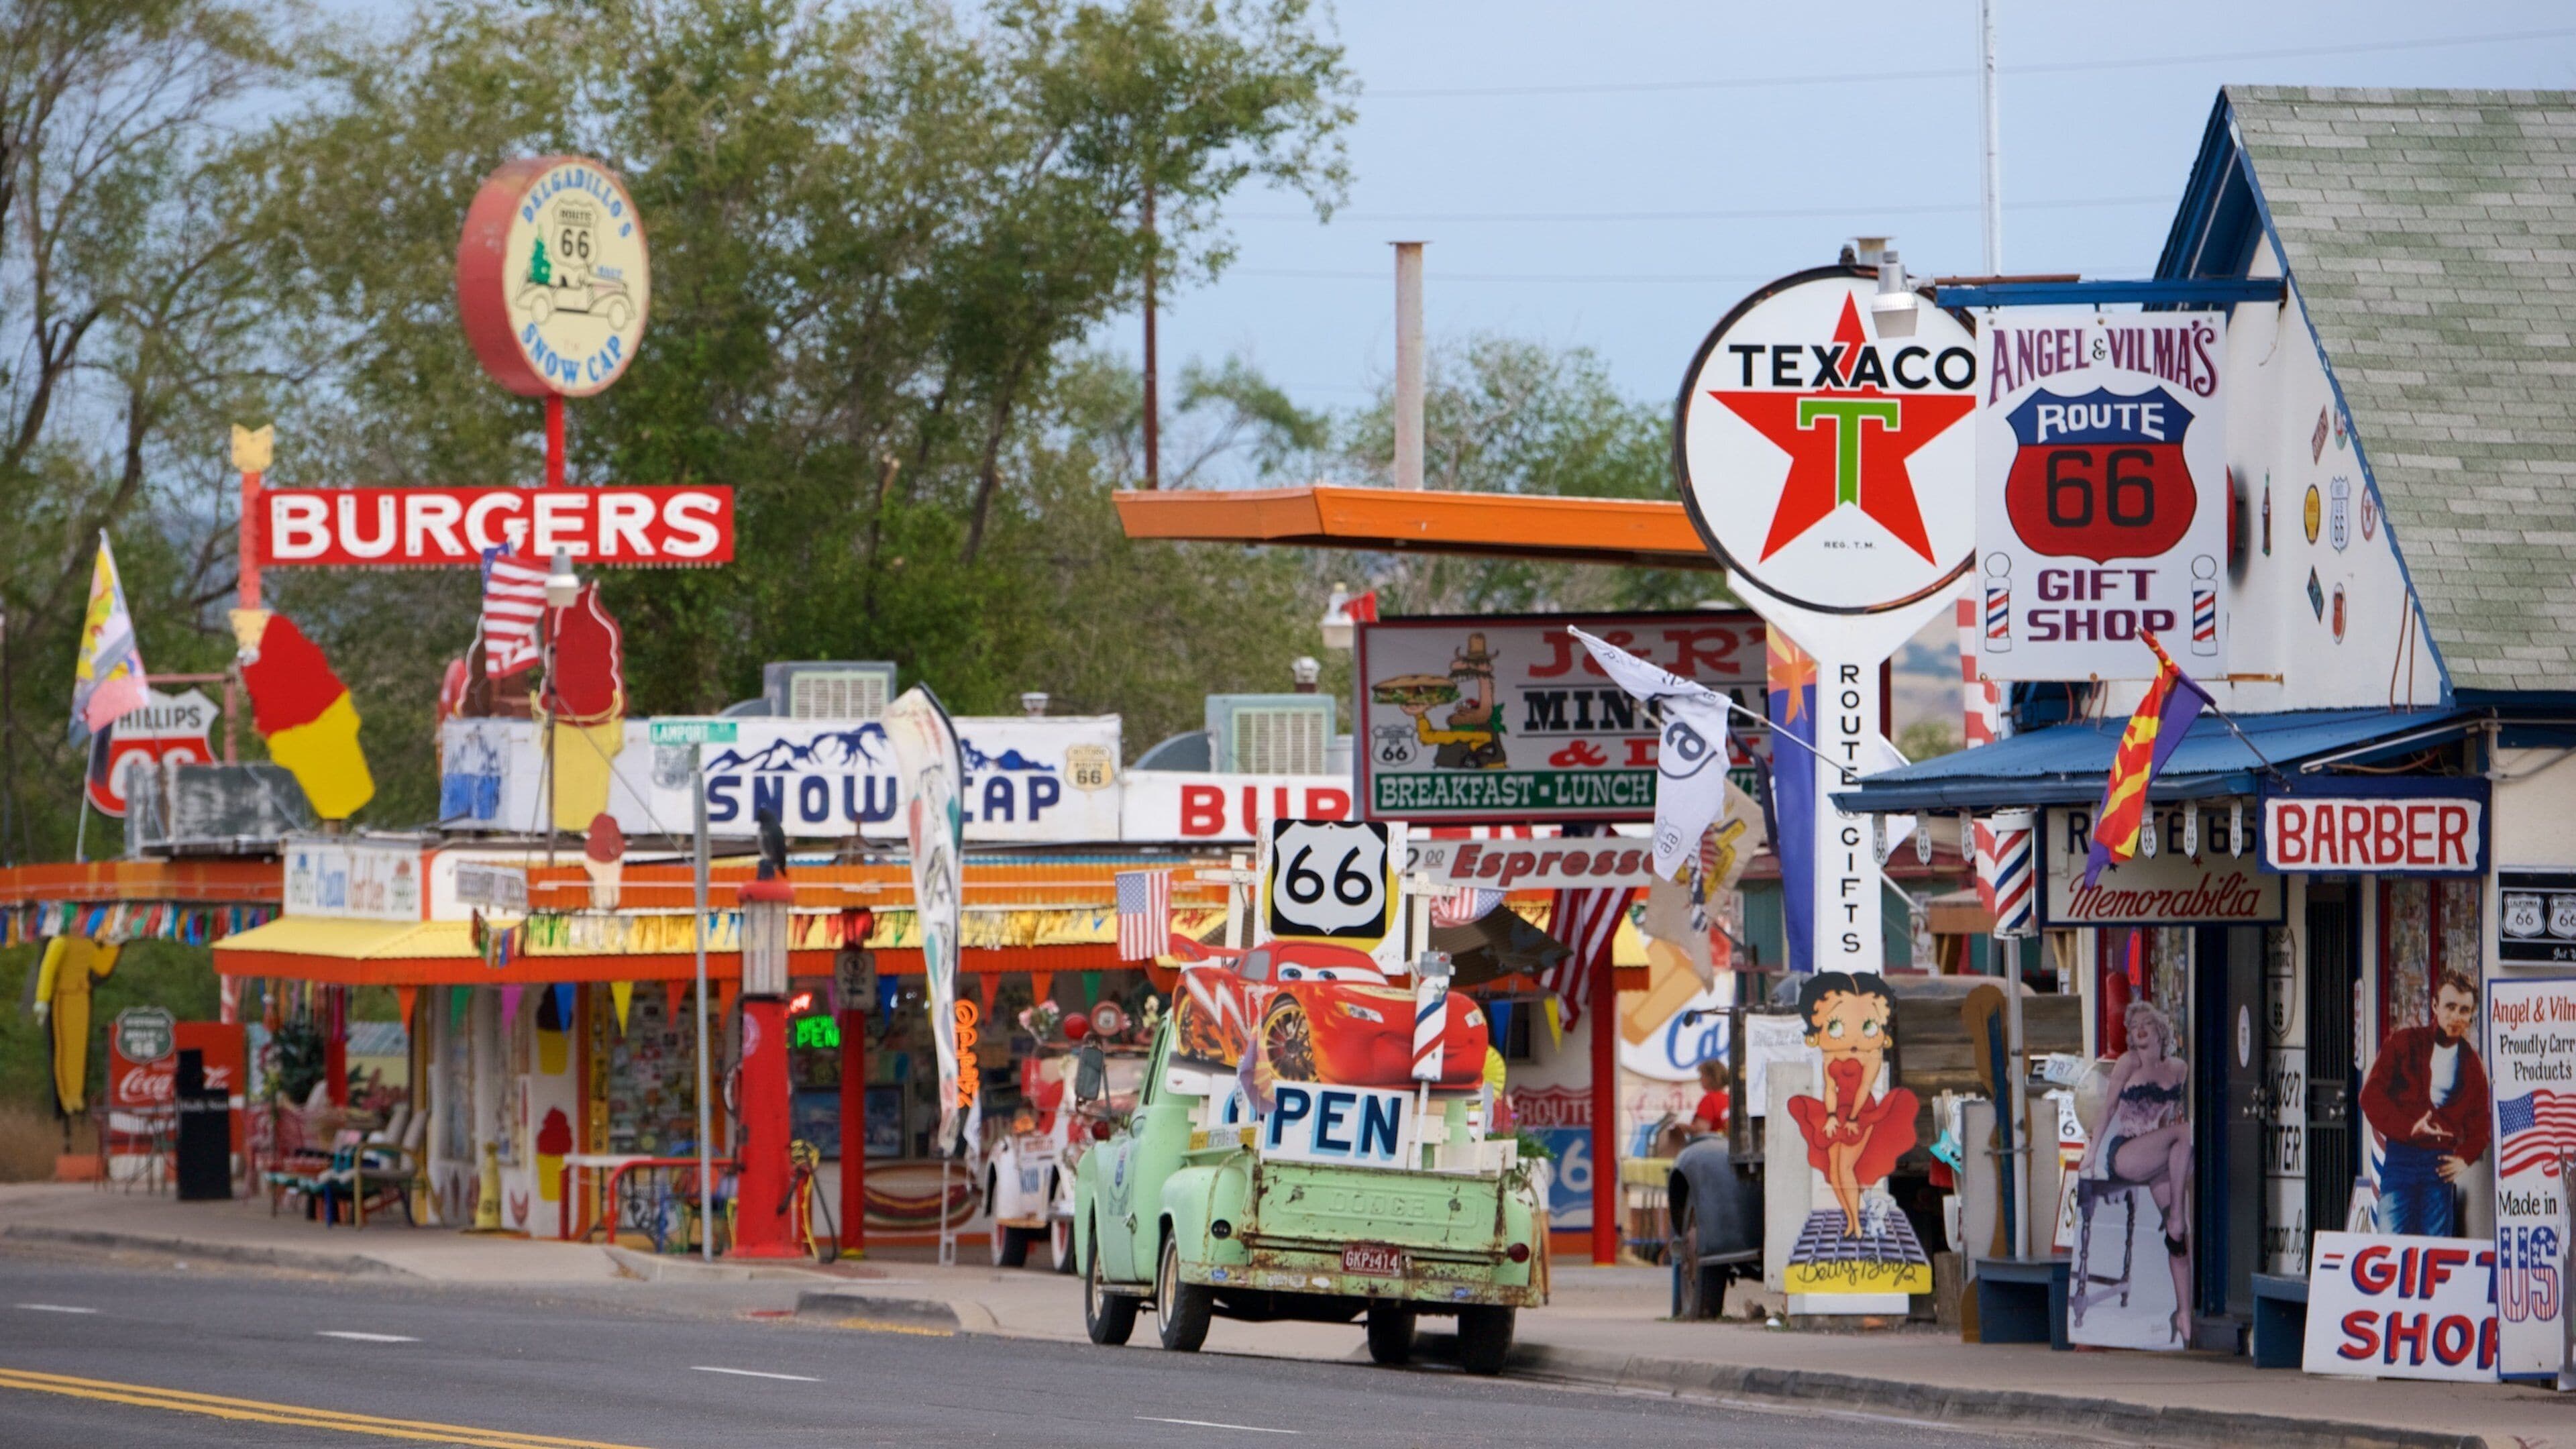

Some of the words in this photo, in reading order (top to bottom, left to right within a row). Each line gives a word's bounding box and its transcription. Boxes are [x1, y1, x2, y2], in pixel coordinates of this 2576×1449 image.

[561, 228, 590, 260] 66
[521, 322, 581, 384] SNOW
[587, 334, 622, 382] CAP
[1729, 344, 1976, 388] TEXACO
[1988, 327, 2090, 410] ANGEL
[2092, 338, 2107, 360] &
[2105, 319, 2216, 398] VILMA'S
[2036, 403, 2165, 443] ROUTE
[2045, 448, 2155, 528] 66
[270, 492, 723, 559] BURGERS
[2037, 569, 2159, 601] GIFT
[2027, 608, 2178, 642] SHOP
[119, 706, 201, 730] HILLIPS
[651, 724, 708, 742] LAMPORT
[1840, 665, 1862, 786] ROUTE
[1383, 745, 1407, 761] 66
[1549, 741, 1607, 766] &
[1077, 769, 1102, 785] 66
[1380, 775, 1535, 806] BREAKFAST
[1555, 775, 1650, 804] LUNCH
[708, 776, 897, 822] SNOW
[2277, 804, 2469, 866] BARBER
[1285, 844, 1373, 906] 66
[1840, 827, 1862, 953] GIFTS
[2068, 871, 2261, 920] Memorabilia
[2516, 912, 2534, 926] 66
[2492, 997, 2530, 1031] Angel
[2534, 996, 2544, 1022] &
[796, 1027, 840, 1049] PEN
[2500, 1033, 2547, 1059] Proudly
[2514, 1060, 2572, 1082] Products
[2498, 1191, 2540, 1217] Made
[2544, 1190, 2557, 1216] in
[1796, 1255, 1857, 1287] Betty
[1860, 1253, 1917, 1288] Boop
